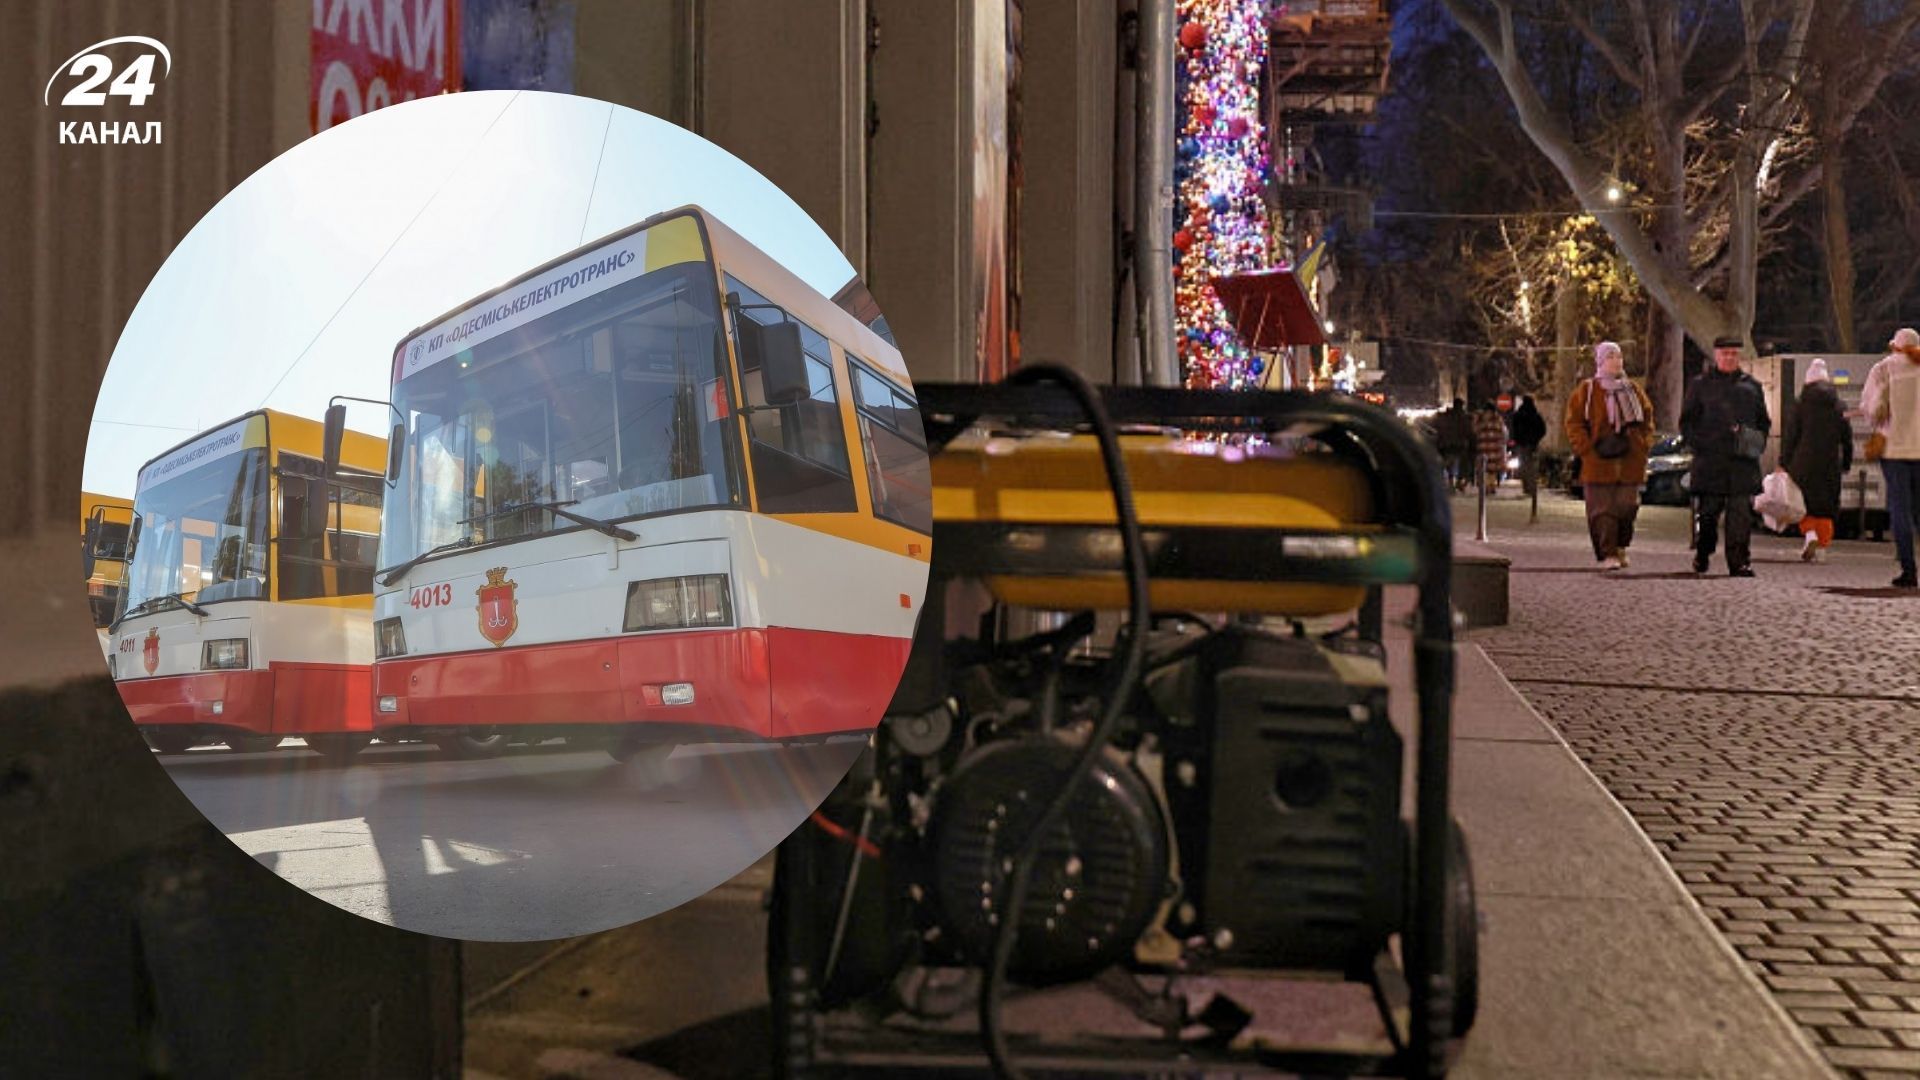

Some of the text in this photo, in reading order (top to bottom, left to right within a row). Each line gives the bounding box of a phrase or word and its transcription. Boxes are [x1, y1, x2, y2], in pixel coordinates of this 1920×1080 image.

[428, 250, 636, 354] КП «ОДЕСМІСЬКЕЛЕКТРОТРАНС»
[411, 583, 452, 609] 4013
[119, 638, 136, 653] 4011
